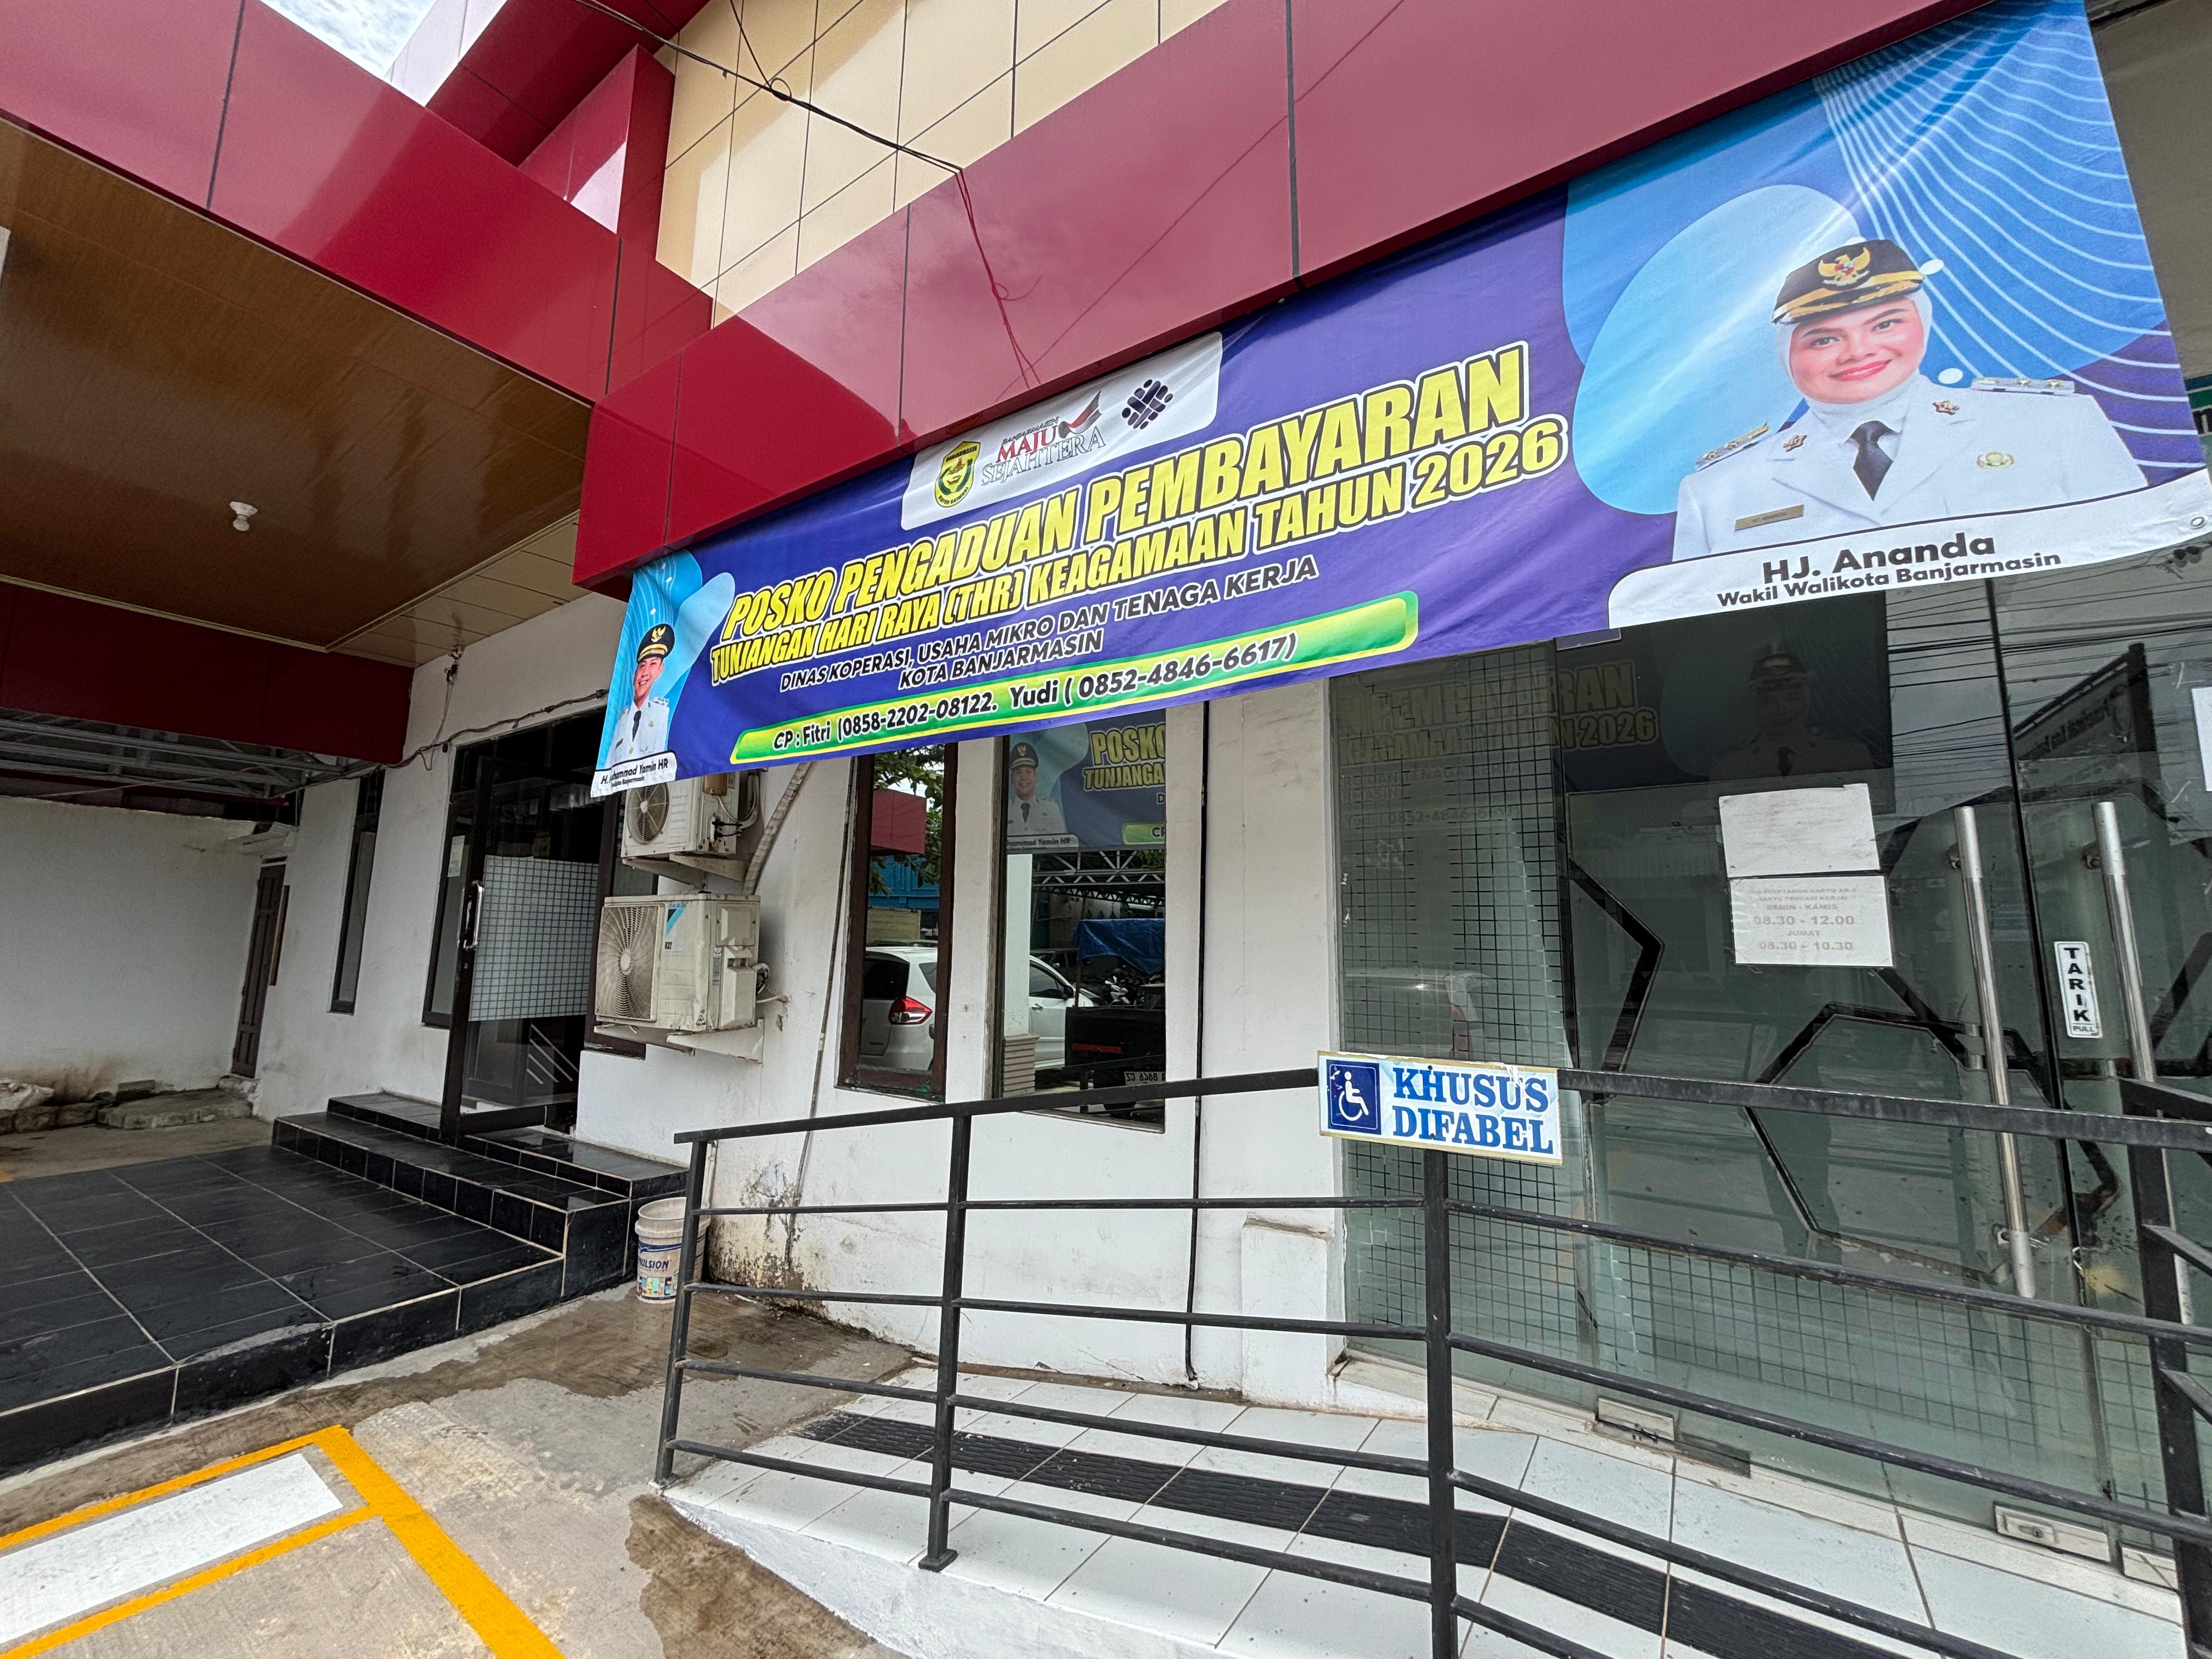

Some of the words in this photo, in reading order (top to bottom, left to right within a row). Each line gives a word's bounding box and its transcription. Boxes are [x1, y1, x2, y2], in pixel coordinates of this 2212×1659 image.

[981, 426, 1106, 486] SEJAHTERA
[996, 425, 1058, 463] MAJU
[721, 570, 836, 640] POSKO
[834, 488, 1079, 613] PENGADUAN
[1085, 345, 1525, 543] PEMBAYARAN
[712, 627, 816, 683] TUNJANGAN
[816, 608, 876, 656] HARI
[880, 594, 939, 641] RAYA
[943, 570, 1025, 625] (THR)
[1027, 507, 1248, 605] KEAGAMAAN
[1255, 461, 1408, 549] TAHUN
[1411, 420, 1562, 508] 2026
[1763, 556, 1821, 584] HJ.
[1832, 533, 1995, 574] Ananda
[1718, 582, 1778, 607] Wakil
[1784, 570, 1889, 597] Walikota
[1897, 552, 2061, 585] Banjarmasin
[781, 668, 826, 691] DINAS
[828, 650, 915, 681] KOPERASI,
[918, 637, 980, 666] USAHA
[985, 618, 1054, 648] MIKRO
[1059, 604, 1108, 630] DAN
[1113, 579, 1219, 620] TENAGA
[1226, 557, 1317, 596] KERJA
[900, 666, 946, 689] KOTA
[952, 631, 1103, 675] BANJARMASIN
[774, 731, 793, 749] CP
[803, 726, 831, 746] Fitri
[838, 692, 997, 743] (0858-2202-08122.
[1011, 682, 1059, 709] Yudi
[1081, 633, 1298, 701] 0852-4846-6617)
[1578, 709, 1656, 747] 2026
[640, 761, 656, 774] Yamin
[658, 758, 668, 770] HR
[1084, 762, 1165, 790] TUNJANGA
[1753, 916, 1796, 925] 08.30
[1810, 915, 1855, 925] 12.00
[1759, 941, 1797, 950] 08.30
[1814, 941, 1853, 950] 10.30
[2063, 947, 2091, 1022] TARIK
[1392, 1067, 1549, 1113] KHUSUS
[1392, 1105, 1554, 1154] DIFABEL
